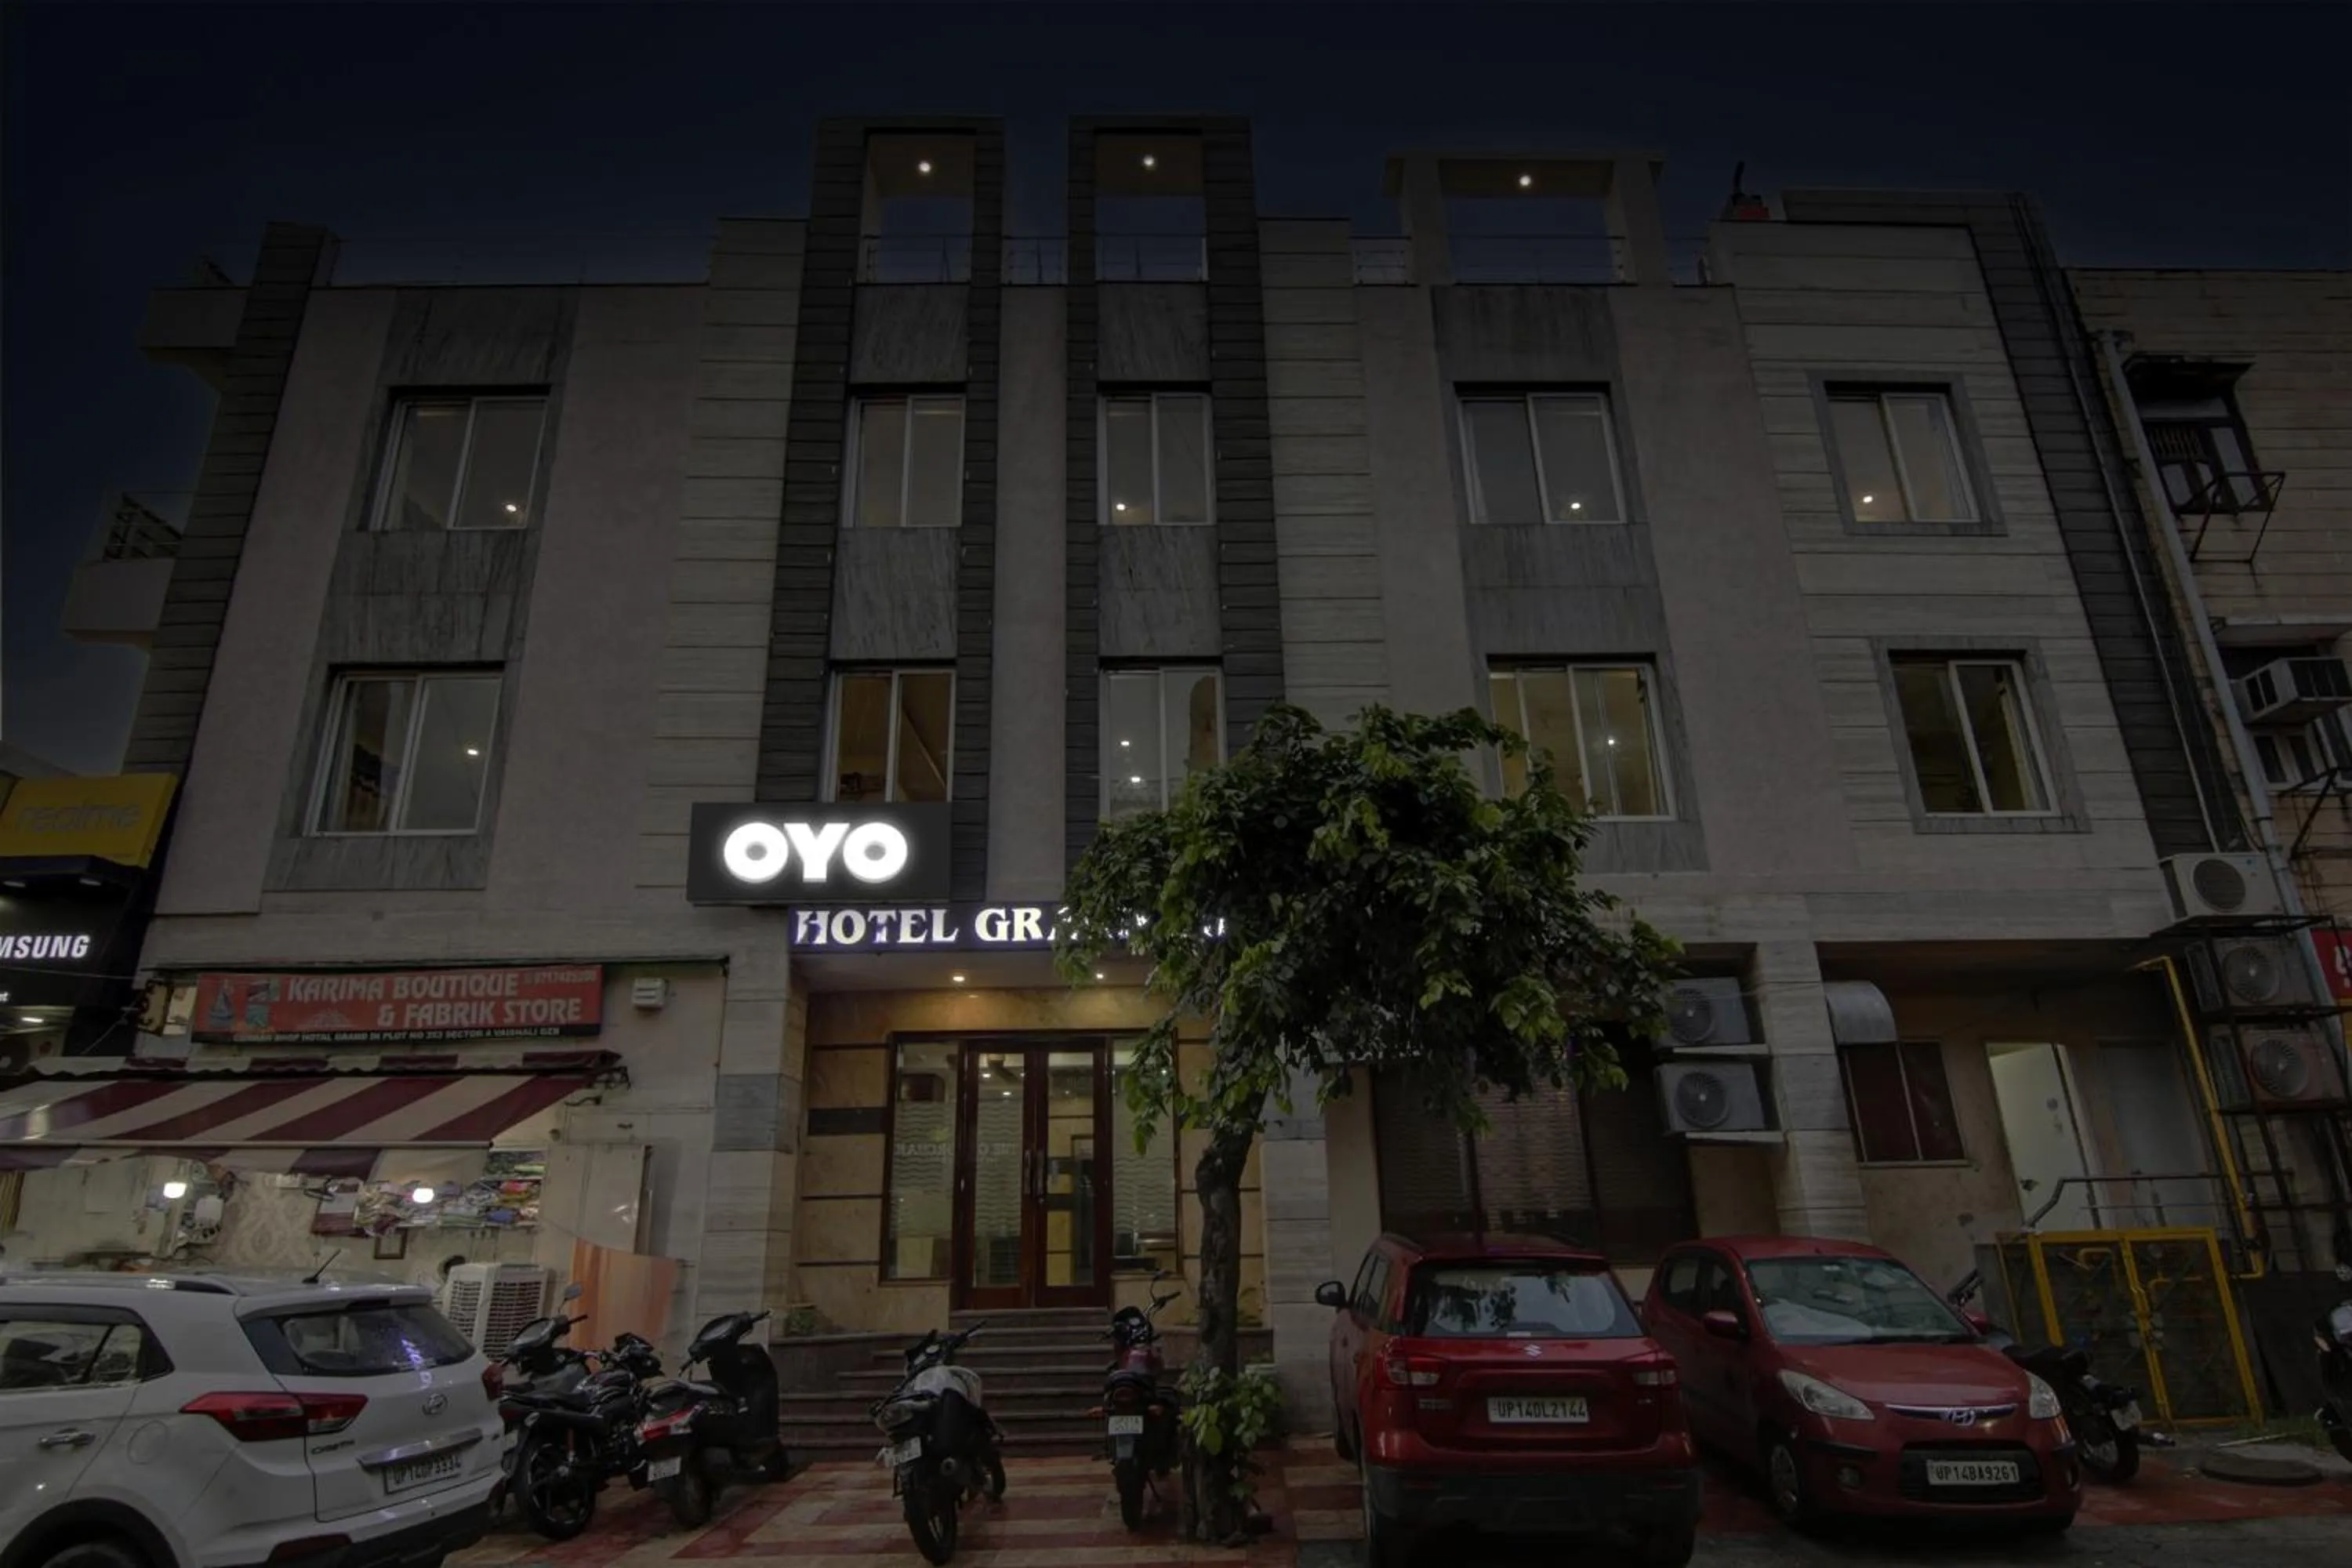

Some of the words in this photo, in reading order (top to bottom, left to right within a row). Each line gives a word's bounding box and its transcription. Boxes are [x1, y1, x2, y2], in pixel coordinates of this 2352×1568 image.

[16, 800, 140, 832] realme
[724, 822, 908, 883] OYO
[797, 909, 958, 944] HOTEL
[287, 977, 385, 1003] KARIMA
[392, 973, 519, 1000] BOUTIQUE
[377, 1004, 395, 1027] &
[404, 1000, 496, 1028] FABRIK
[503, 998, 582, 1024] STORE
[383, 1031, 408, 1040] PLOT
